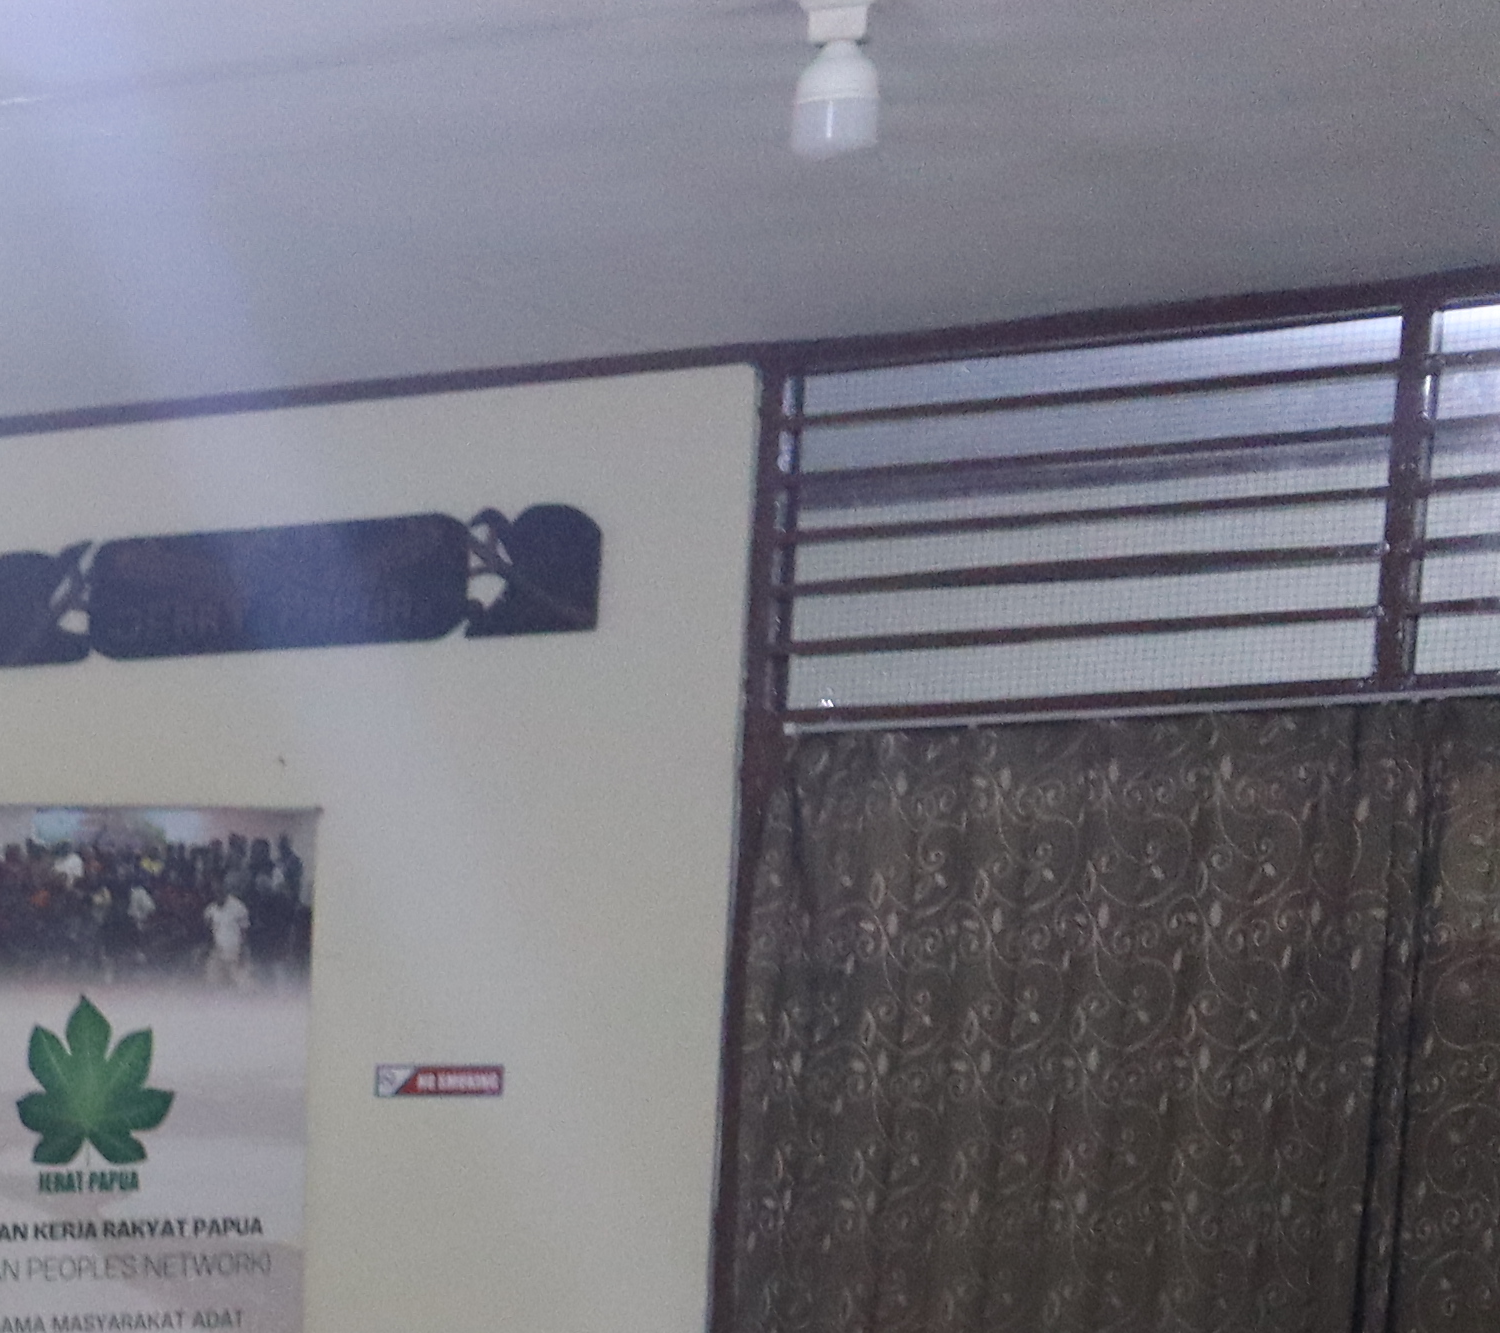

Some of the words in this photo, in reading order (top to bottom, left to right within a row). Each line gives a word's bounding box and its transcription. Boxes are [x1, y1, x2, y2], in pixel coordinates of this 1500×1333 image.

[89, 1171, 140, 1193] PAPUA
[34, 1220, 97, 1241] KERJA
[103, 1218, 187, 1239] RAKYAT
[193, 1216, 263, 1237] PAPUA
[143, 1251, 272, 1279] NETWORK)
[51, 1311, 184, 1333] MASYARAKAT
[192, 1310, 243, 1330] ADAT
